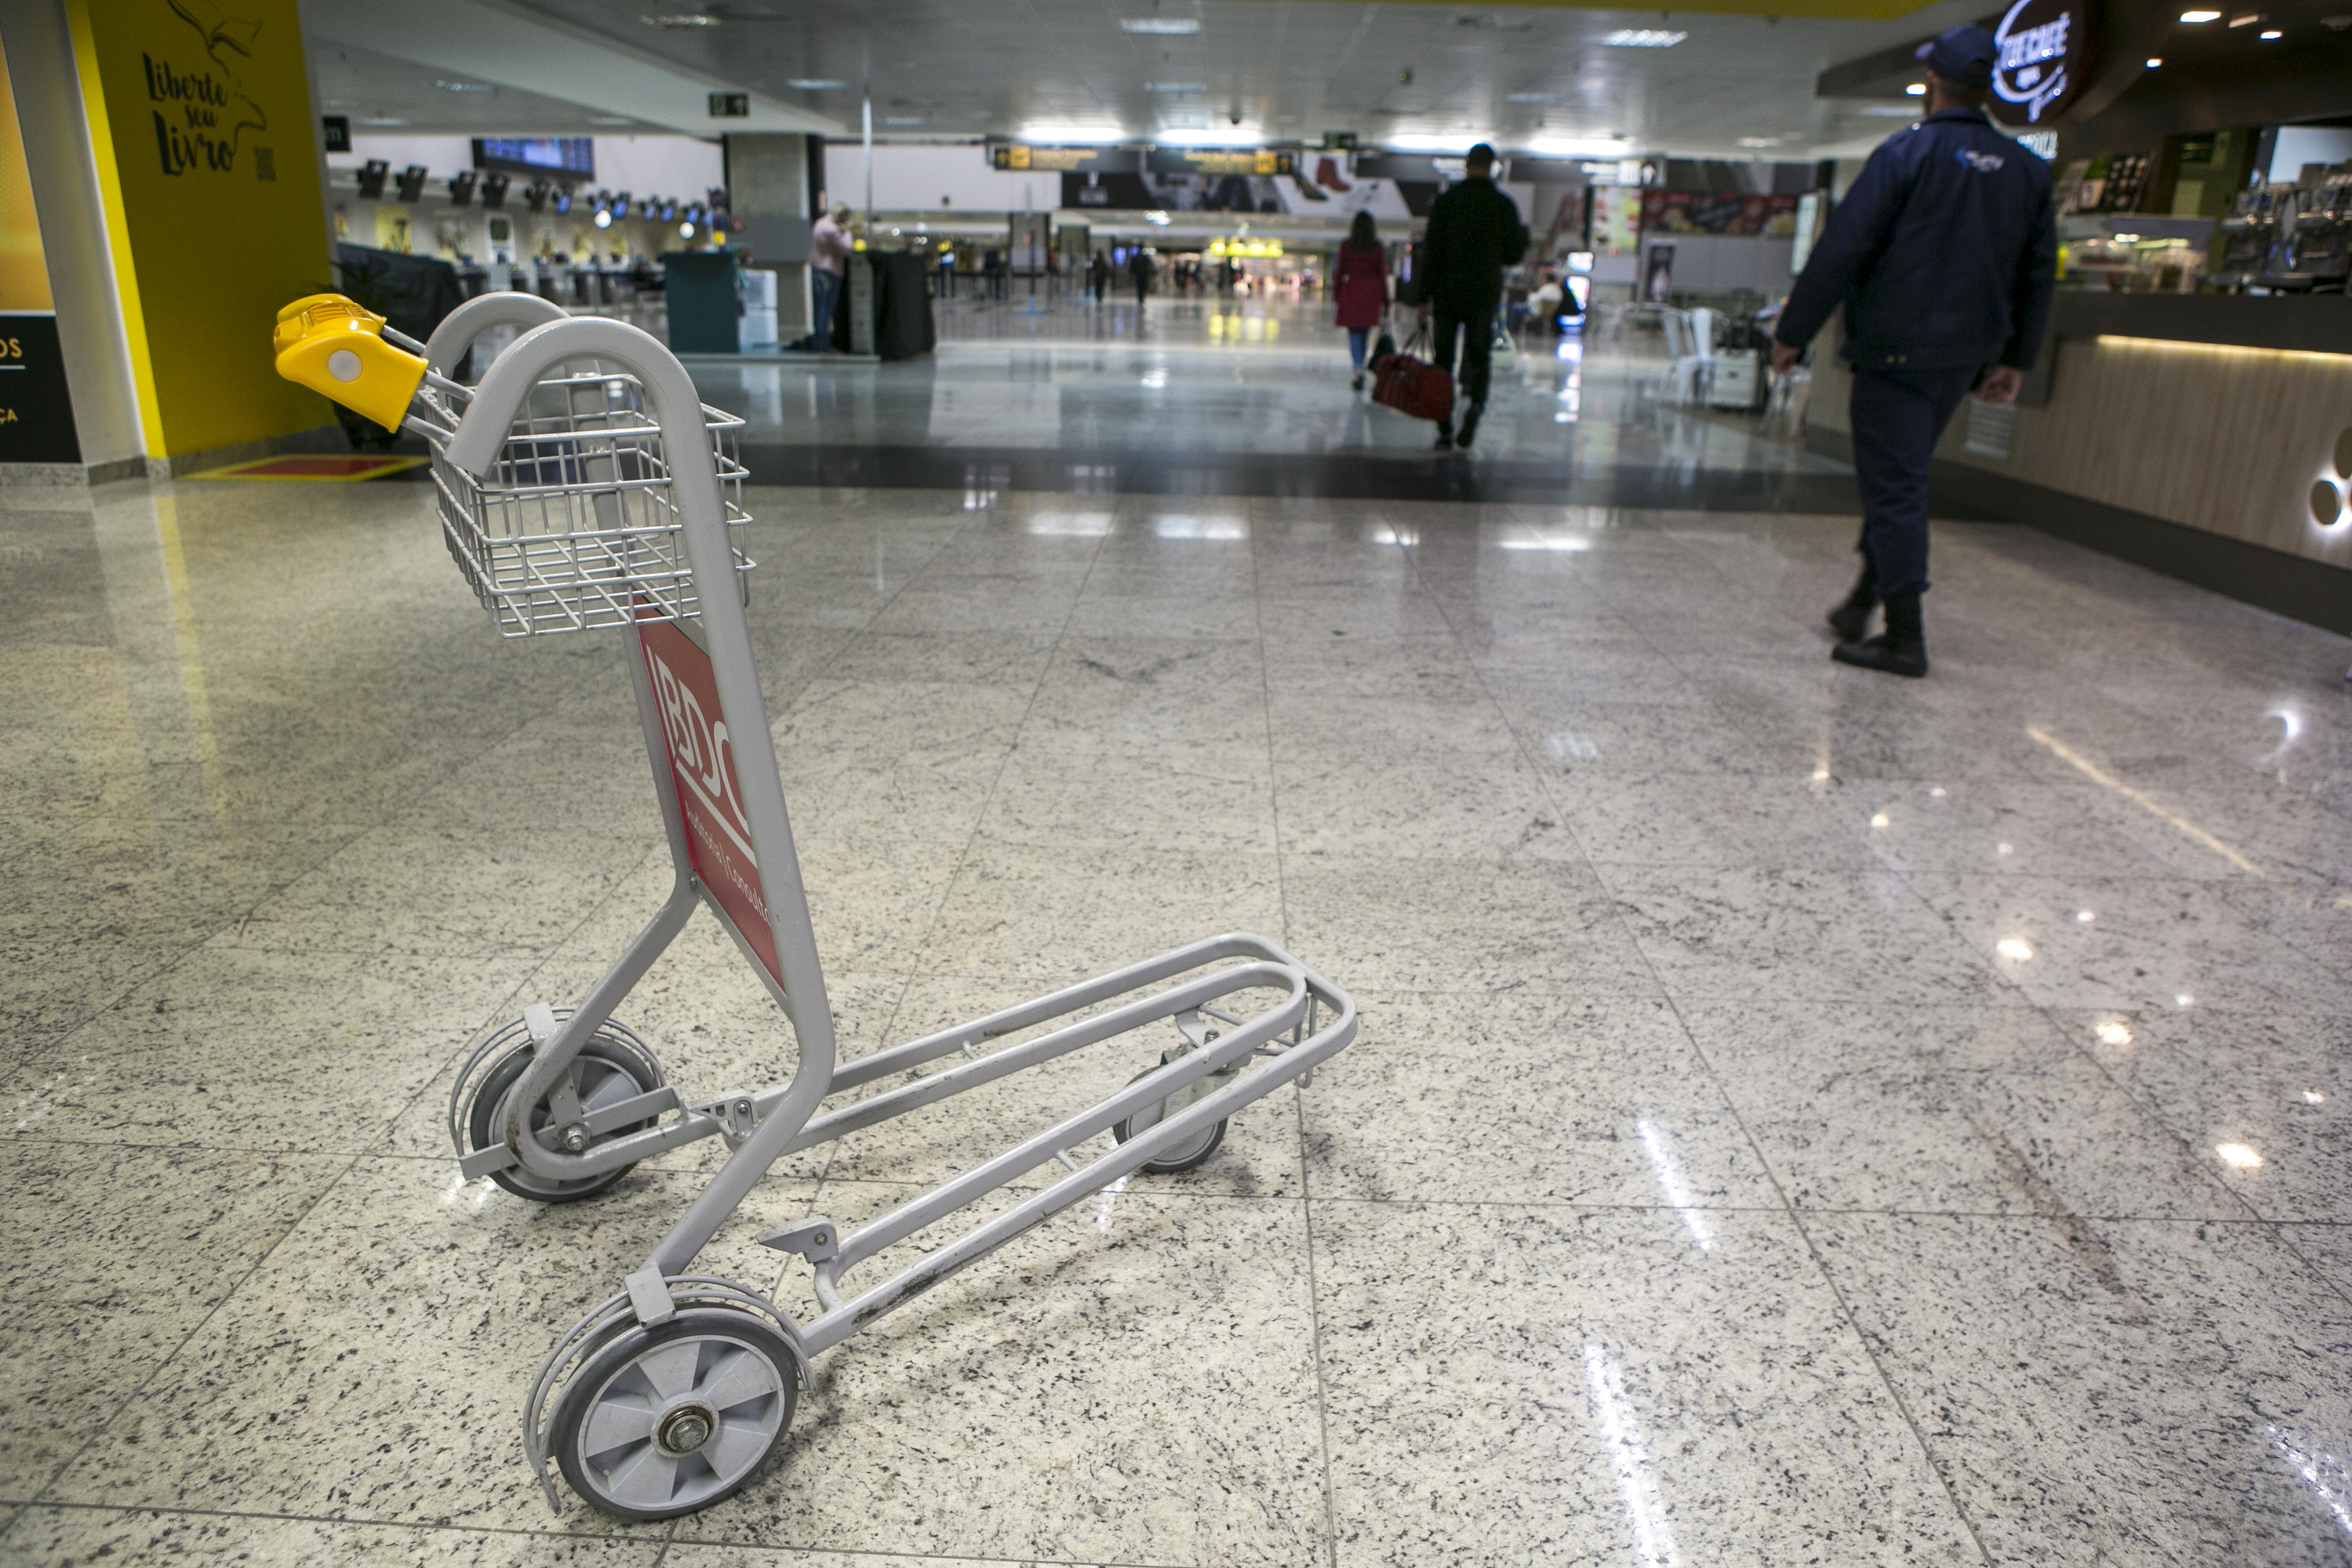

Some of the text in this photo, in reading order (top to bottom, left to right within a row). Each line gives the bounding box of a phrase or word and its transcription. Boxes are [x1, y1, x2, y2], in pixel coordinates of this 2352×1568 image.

[143, 52, 229, 106] Liberte
[153, 109, 233, 176] Livro
[186, 105, 217, 129] seu
